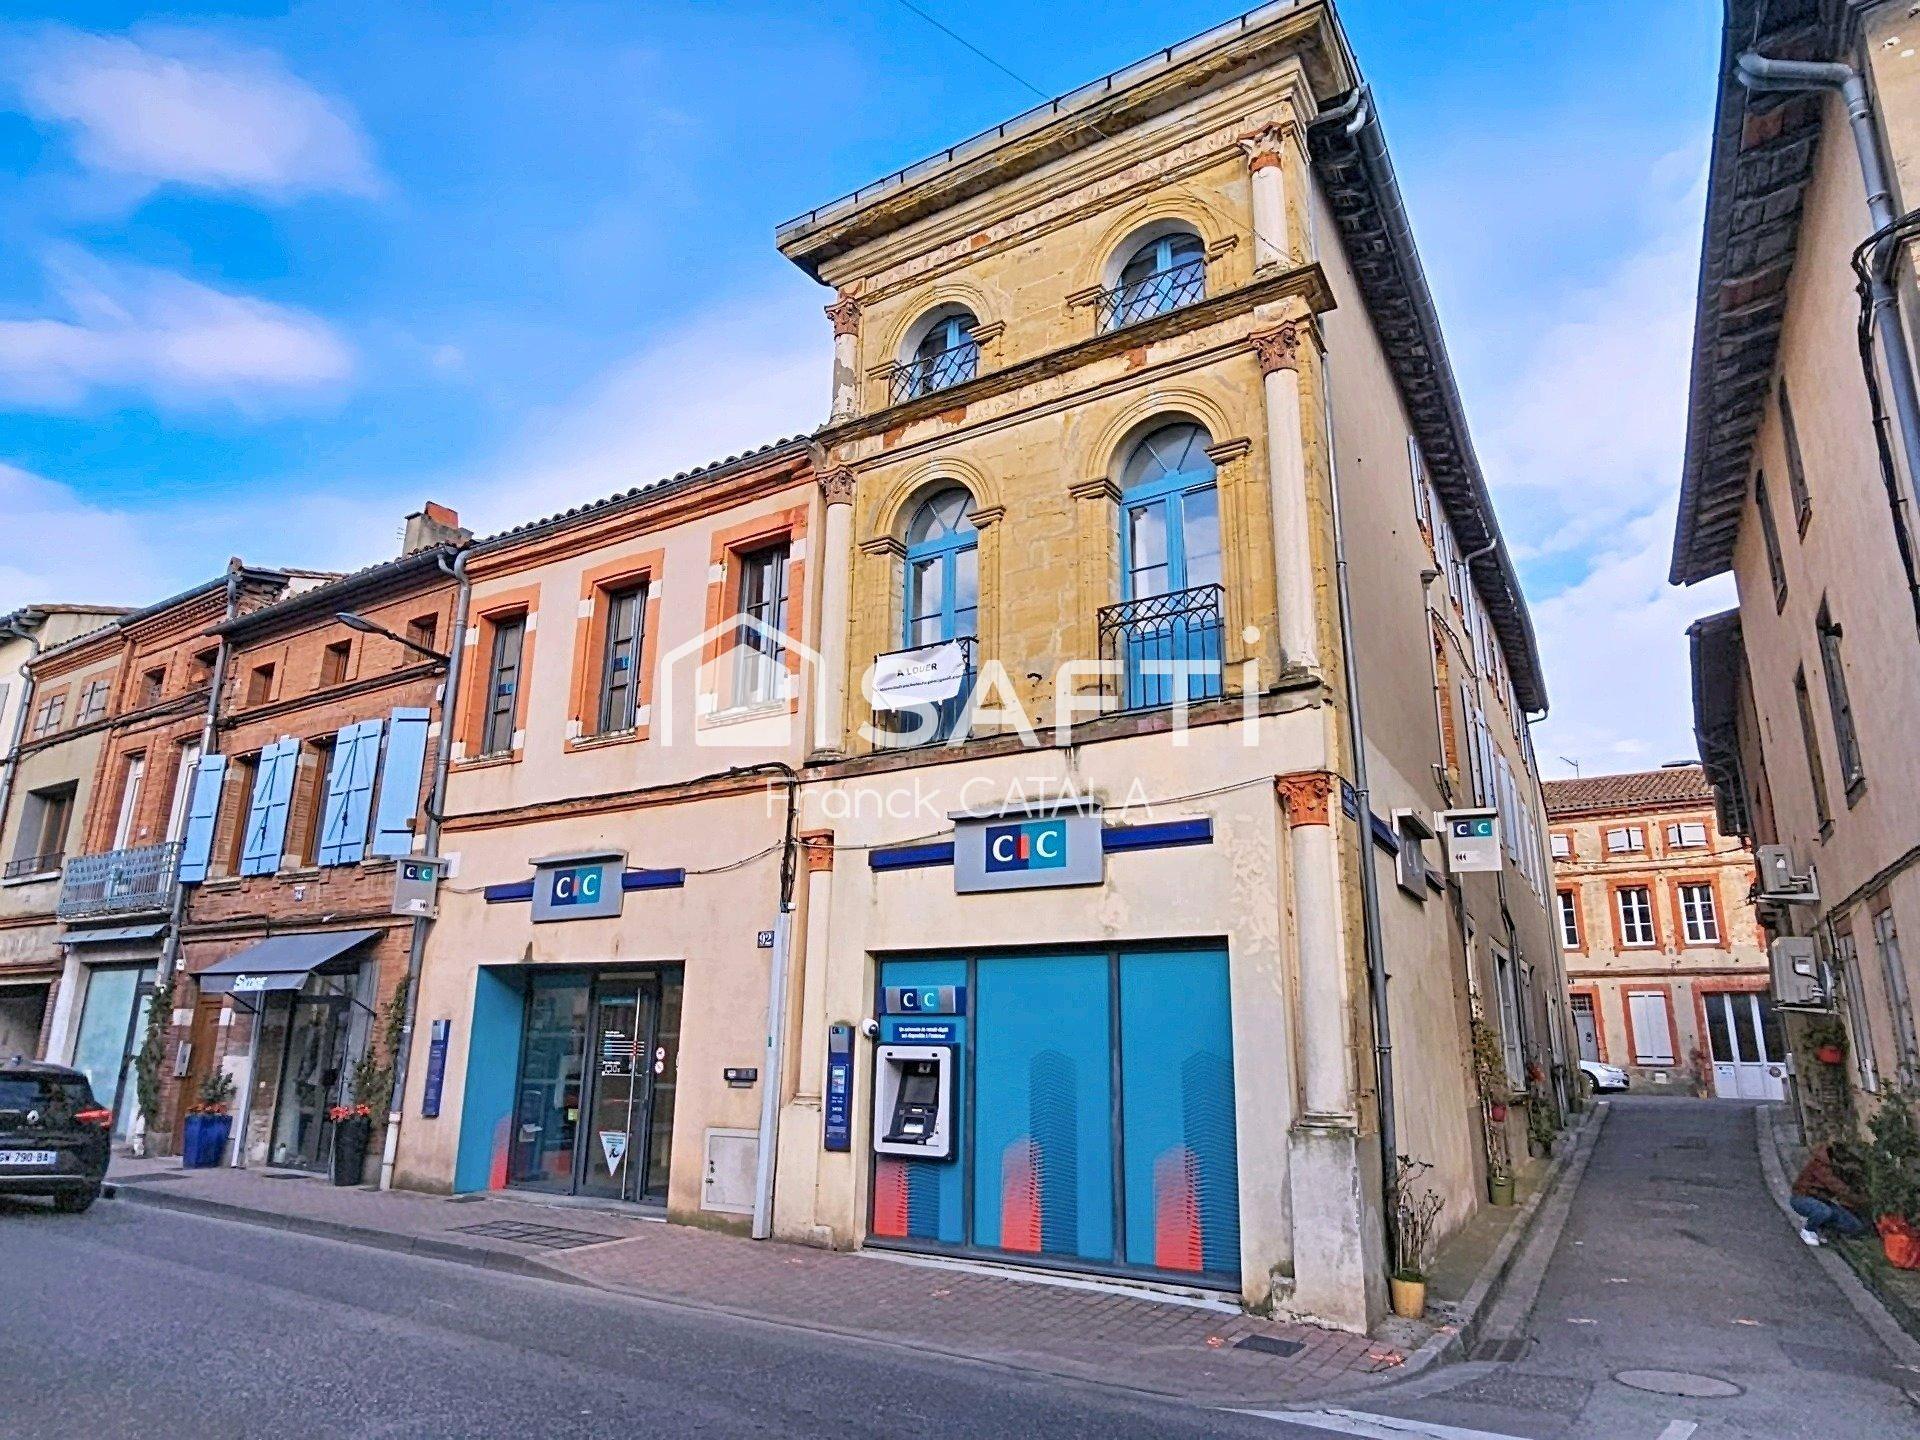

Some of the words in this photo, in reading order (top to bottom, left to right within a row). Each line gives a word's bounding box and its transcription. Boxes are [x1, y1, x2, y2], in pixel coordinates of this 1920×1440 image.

[896, 669, 904, 677] A
[906, 662, 938, 676] LOUER
[1456, 822, 1489, 836] CC
[992, 830, 1059, 863] CIC
[406, 866, 431, 880] CC
[556, 874, 598, 899] CIC
[903, 992, 935, 1008] CC
